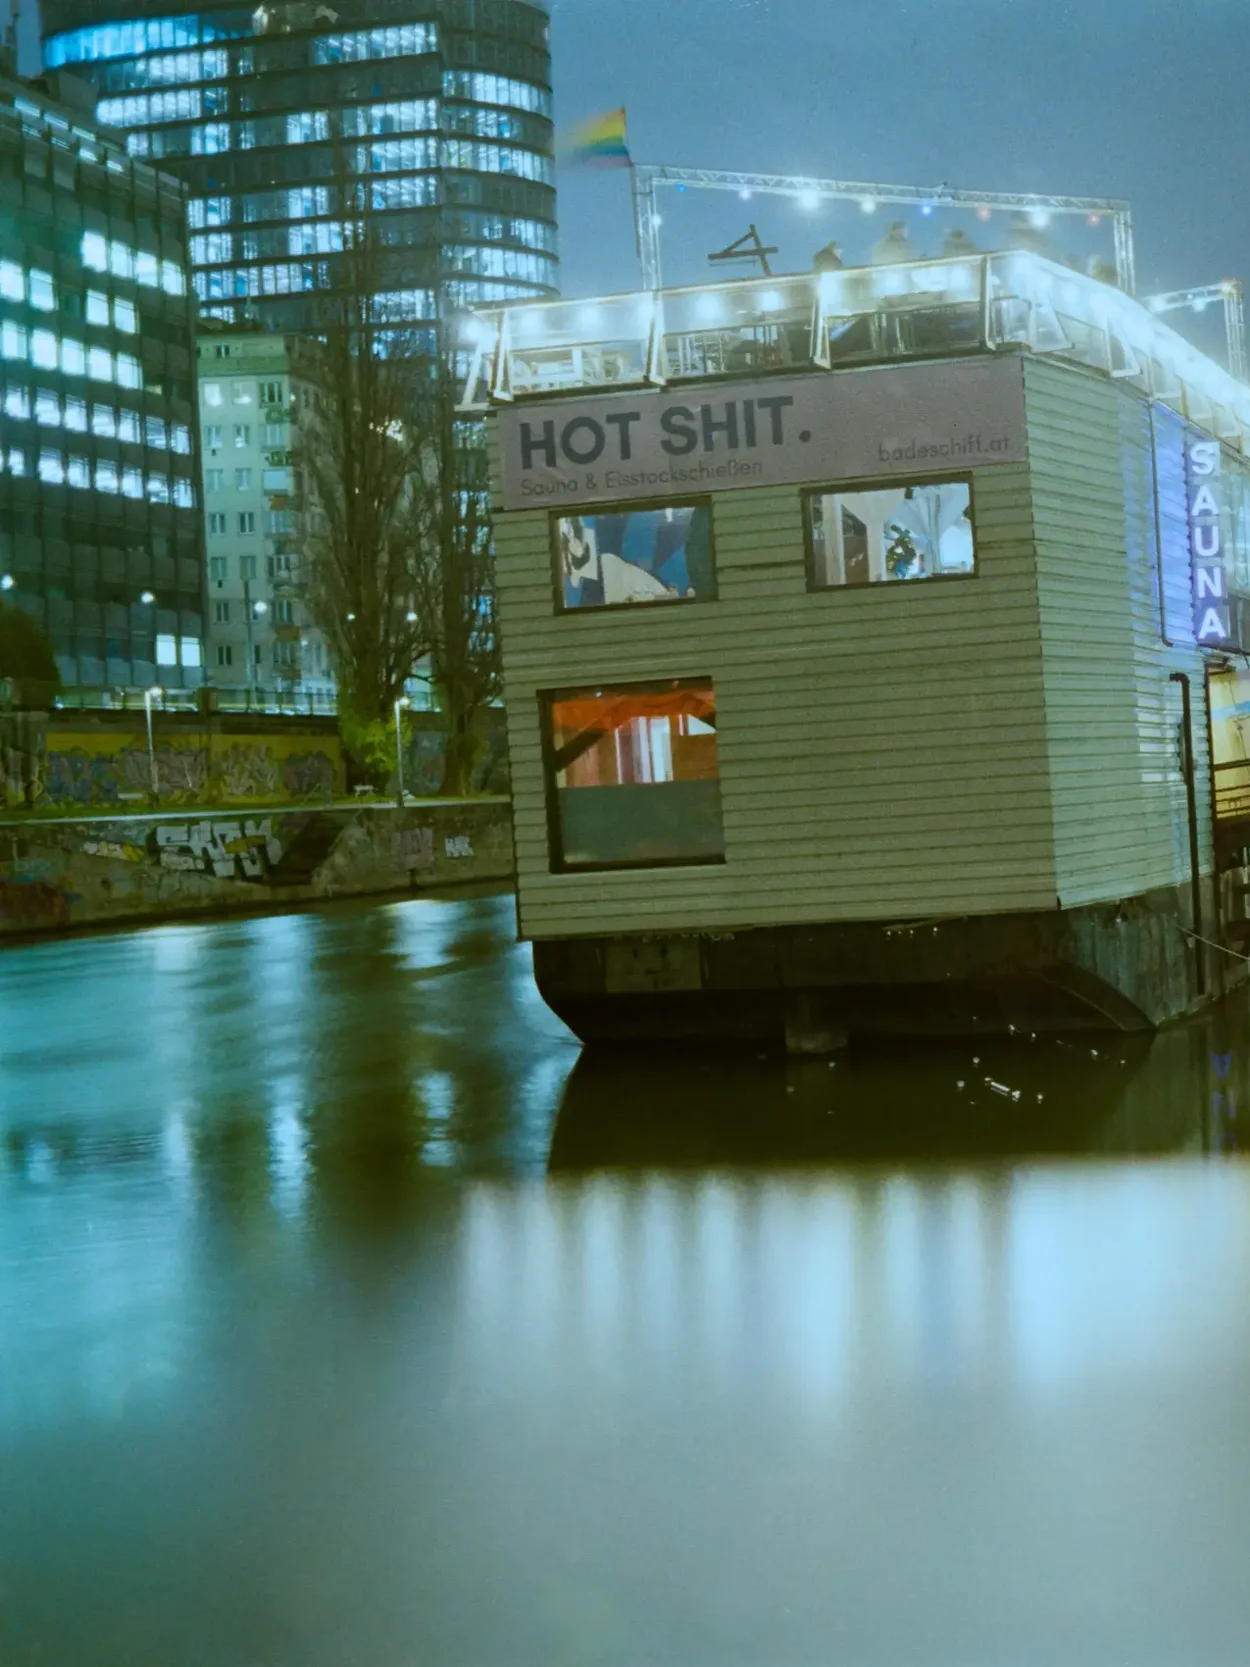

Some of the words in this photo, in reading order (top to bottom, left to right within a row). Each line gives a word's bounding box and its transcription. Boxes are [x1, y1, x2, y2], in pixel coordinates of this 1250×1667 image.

[519, 411, 641, 470] HOT
[659, 395, 811, 456] SHIT.
[878, 434, 1010, 462] badeschiff.at
[520, 478, 578, 497] Sauna
[585, 472, 597, 490] &
[605, 459, 763, 489] Eisstockschießen
[1189, 441, 1227, 640] SAUNA
